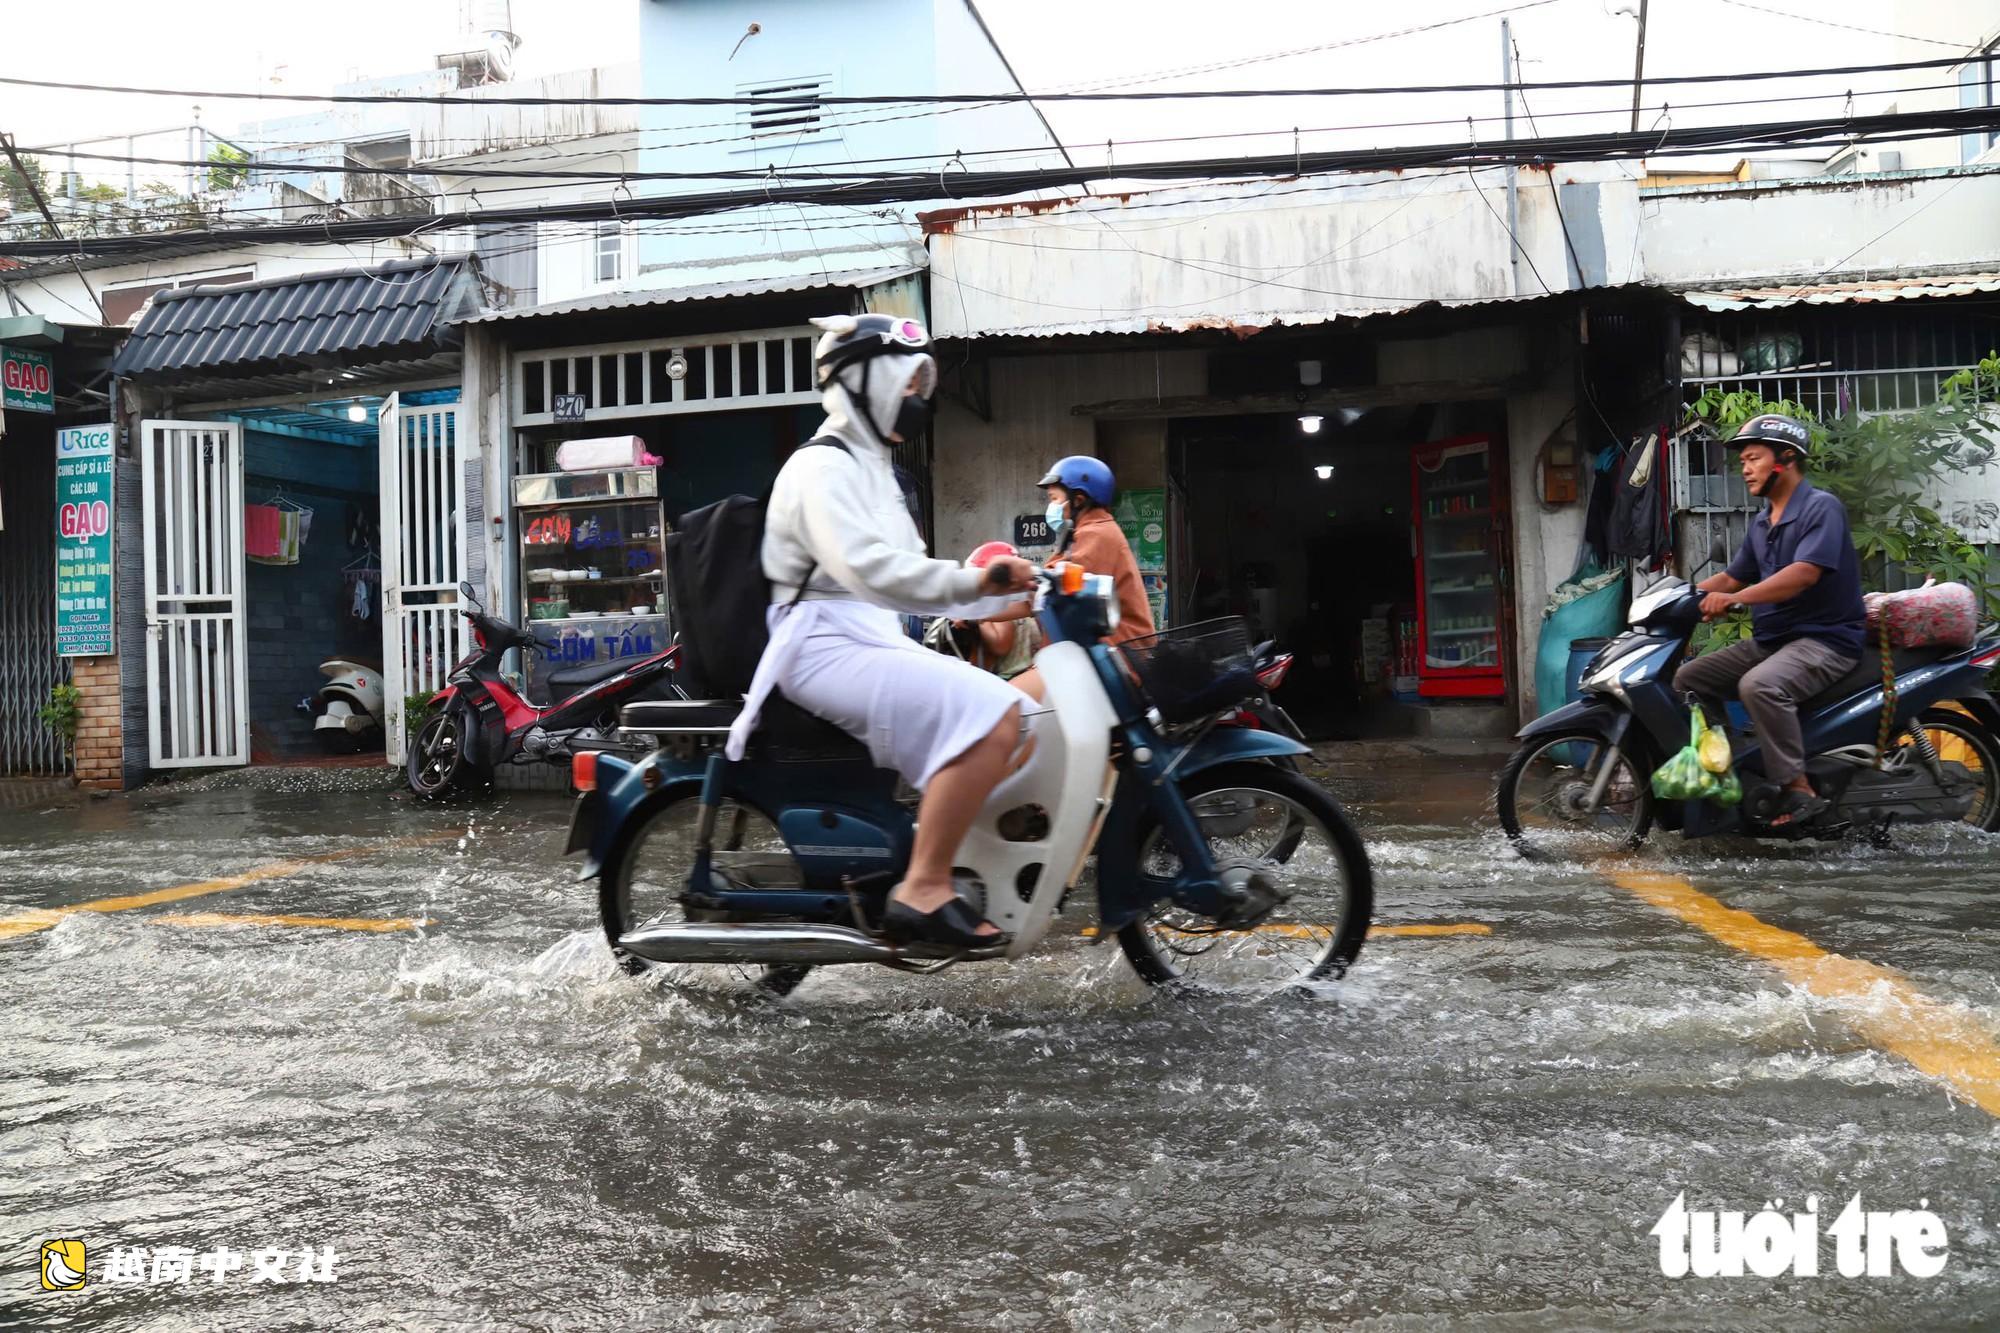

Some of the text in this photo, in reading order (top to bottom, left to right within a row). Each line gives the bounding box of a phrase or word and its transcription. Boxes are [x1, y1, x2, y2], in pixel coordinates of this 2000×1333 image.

[4, 360, 50, 398] GẠO
[556, 397, 584, 416] 270
[62, 431, 109, 451] URice
[58, 464, 75, 477] CUNG
[75, 460, 88, 475] CẤP
[97, 462, 102, 473] &
[70, 481, 98, 496] CÁC LOẠI
[60, 501, 109, 544] GẠO
[1022, 522, 1047, 537] 268
[547, 623, 653, 661] CƠM TẤM
